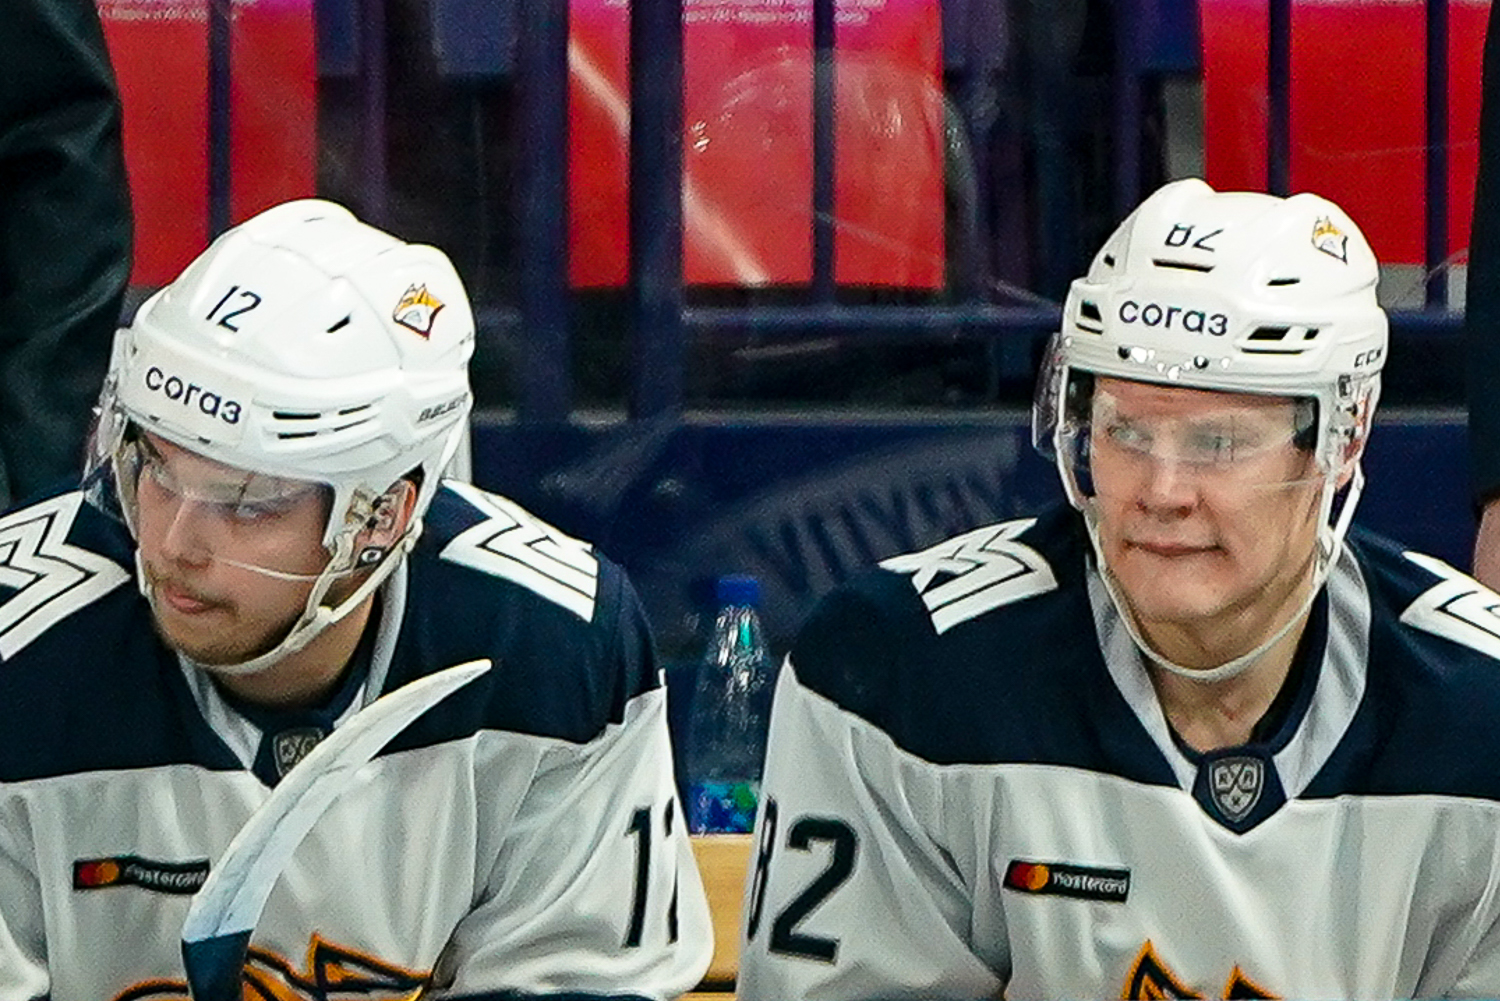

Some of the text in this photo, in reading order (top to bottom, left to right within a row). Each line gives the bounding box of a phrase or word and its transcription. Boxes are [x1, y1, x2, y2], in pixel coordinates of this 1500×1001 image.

[206, 285, 263, 333] 12
[1118, 299, 1229, 337] согаз
[145, 365, 243, 426] согаз
[1052, 871, 1128, 896] mastercard
